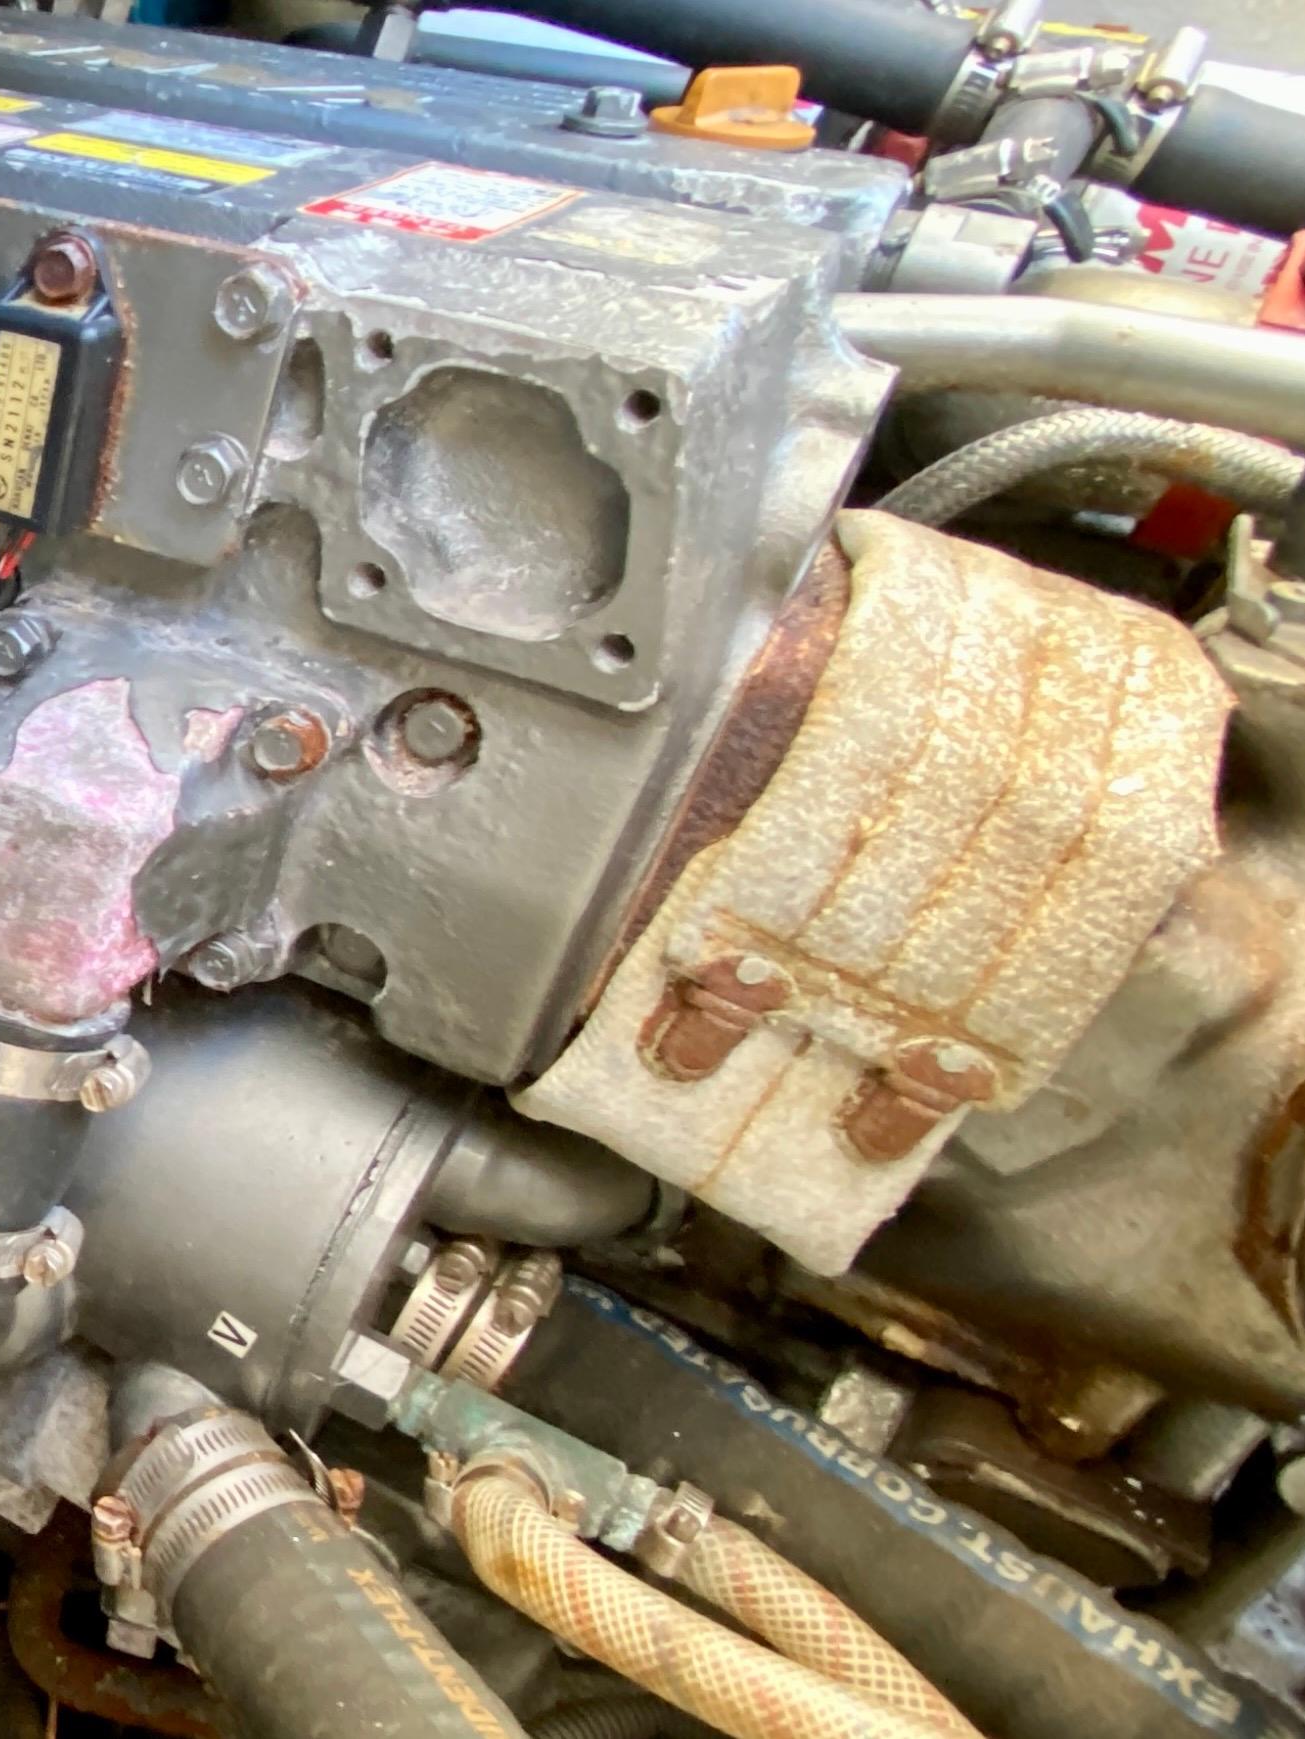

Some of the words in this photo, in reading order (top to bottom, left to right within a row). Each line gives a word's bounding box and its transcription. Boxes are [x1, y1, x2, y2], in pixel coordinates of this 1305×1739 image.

[0, 379, 24, 463] SN2112
[630, 1307, 947, 1526] CORRUGATED
[346, 1568, 508, 1739] IDENT-FLEX
